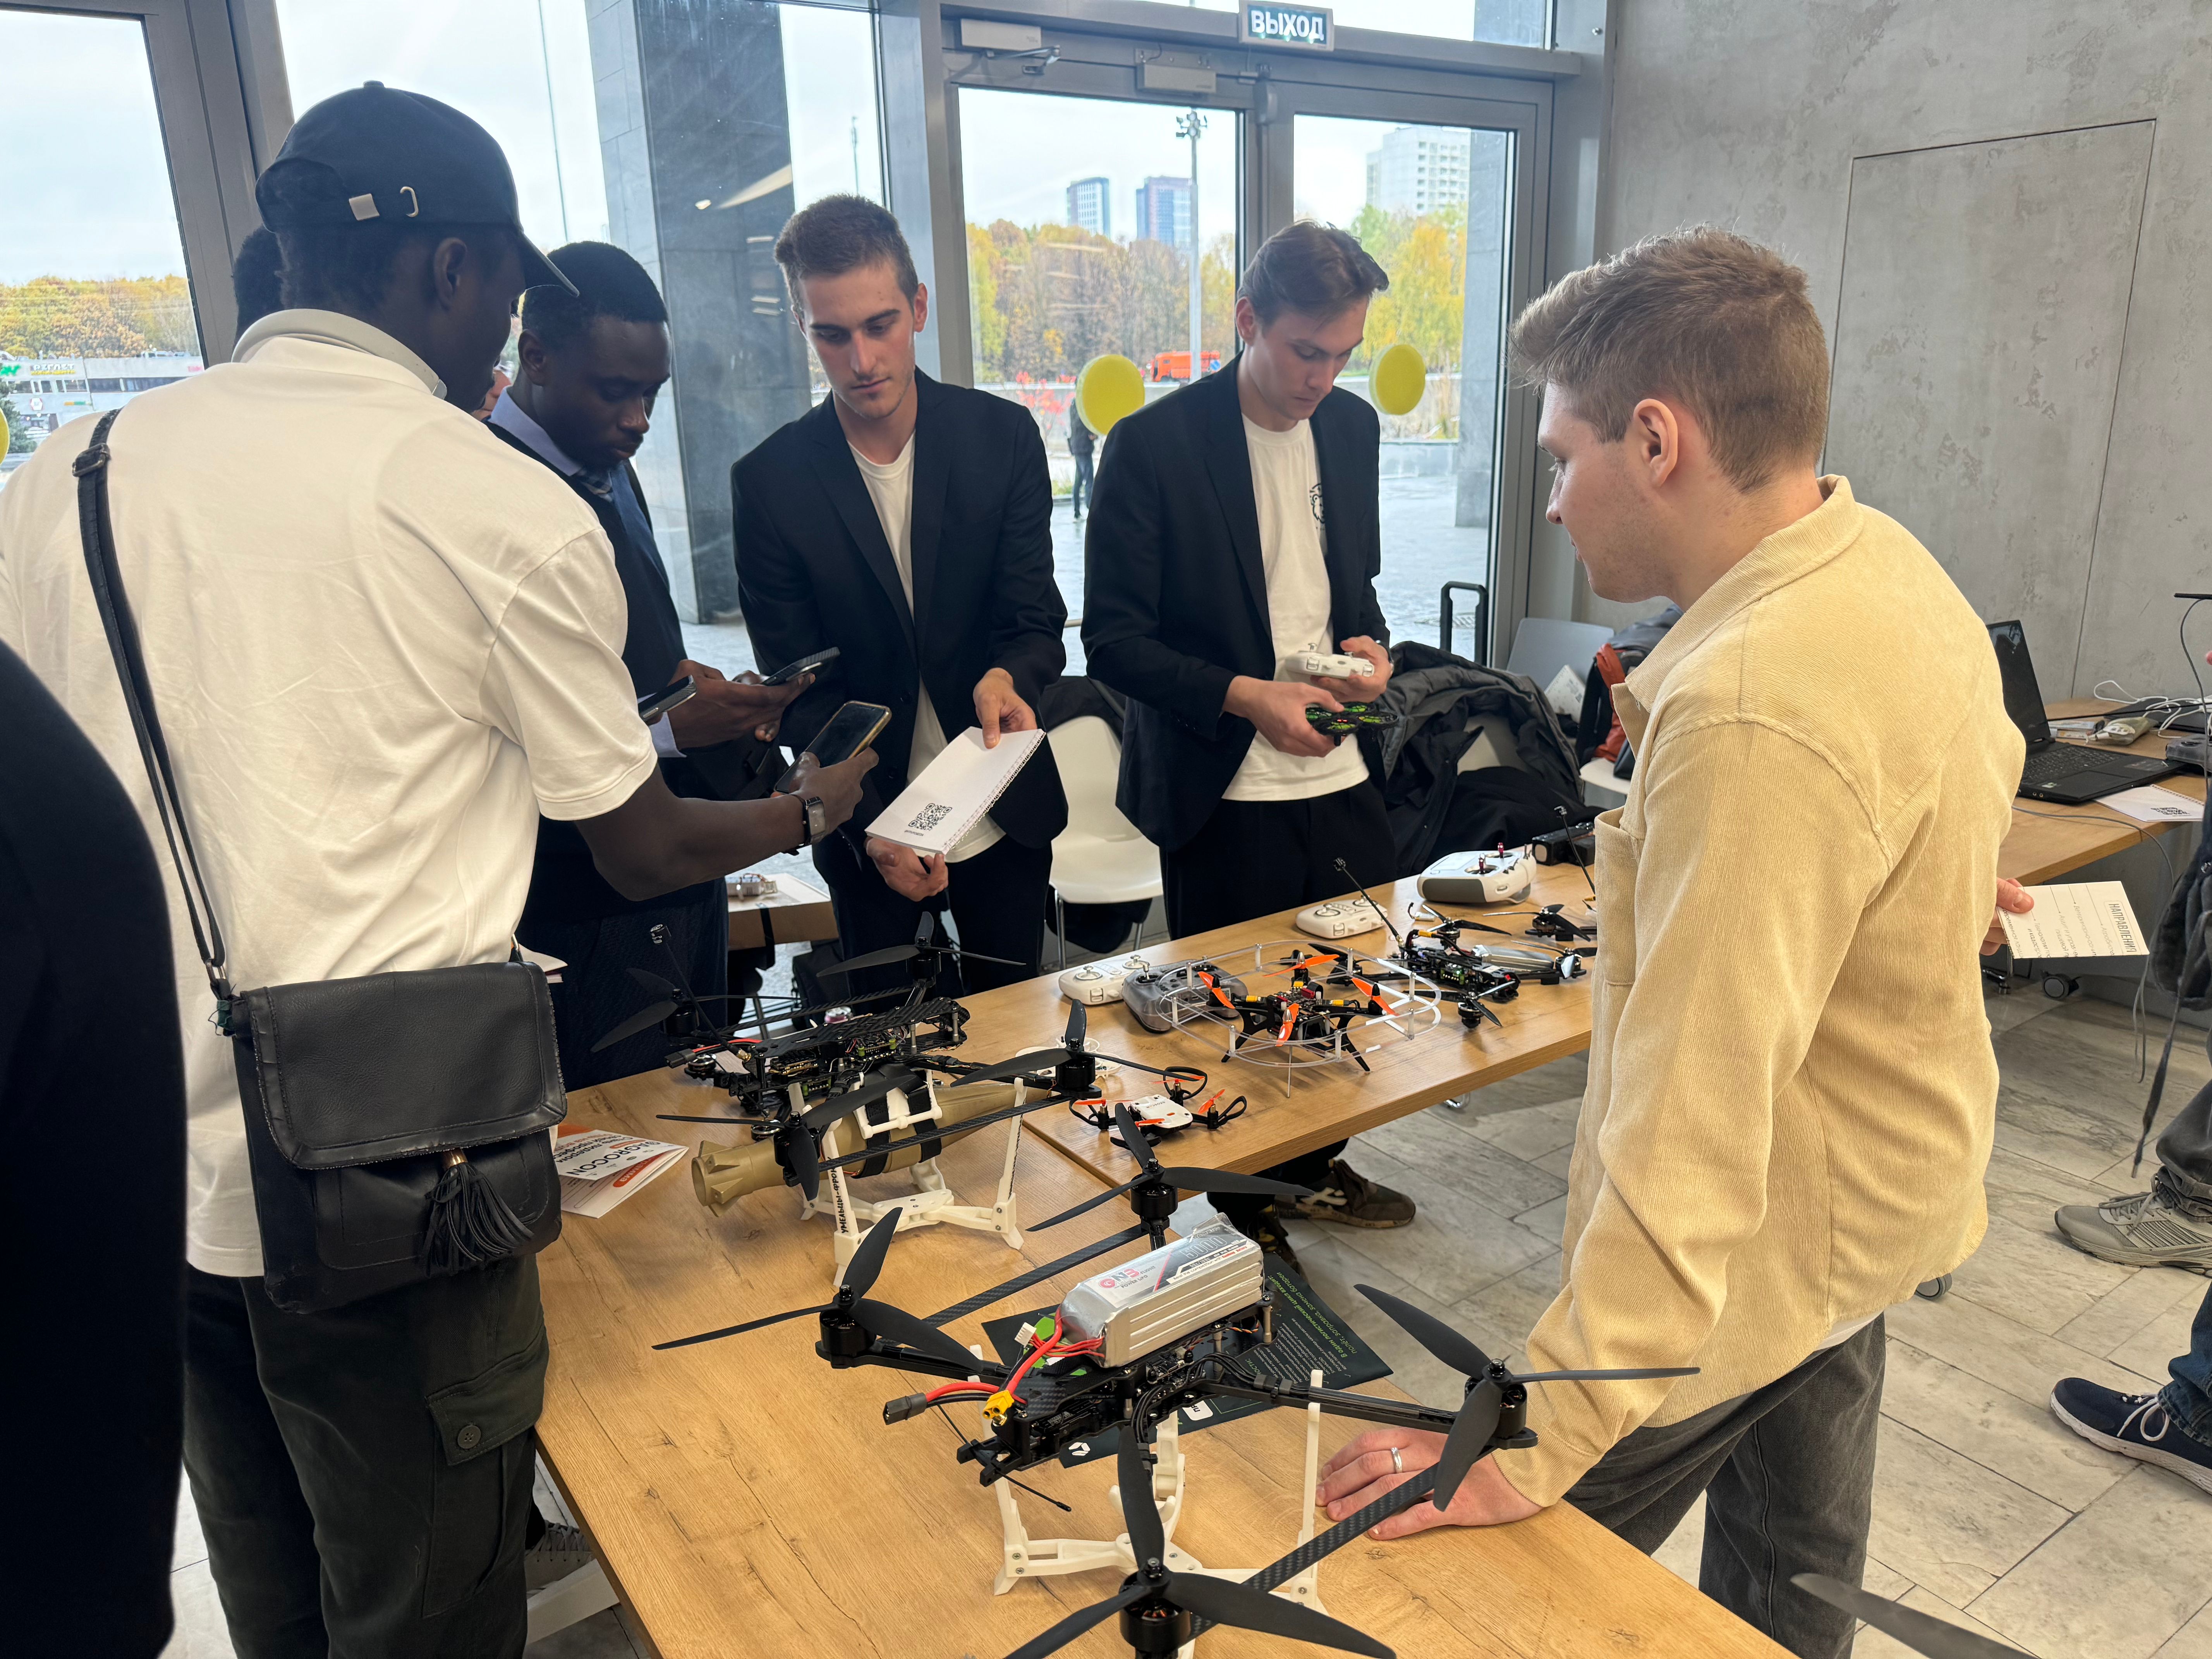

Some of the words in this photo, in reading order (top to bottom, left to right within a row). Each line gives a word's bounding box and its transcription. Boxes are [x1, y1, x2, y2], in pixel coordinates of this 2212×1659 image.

[1251, 10, 1324, 41] ВЫХОД
[2003, 910, 2018, 940] овременная
[2109, 903, 2137, 952] НАПРАВЛЕНИЯ
[556, 1143, 603, 1163] лидером
[566, 1143, 649, 1176] AGROCON
[827, 1157, 848, 1233] УМЕЛЬЦЫ-ФРОН
[1180, 1236, 1227, 1259] 5000
[1121, 1279, 1138, 1288] POWER
[1267, 1275, 1286, 1293] входит:
[1276, 1272, 1298, 1292] батареи
[1284, 1293, 1297, 1305] цикл
[1296, 1292, 1316, 1311] замена
[1294, 1304, 1331, 1340] логистический
[1315, 1310, 1341, 1337] заправка,
[1329, 1339, 1344, 1354] один
[1340, 1336, 1357, 1354] полёт,
